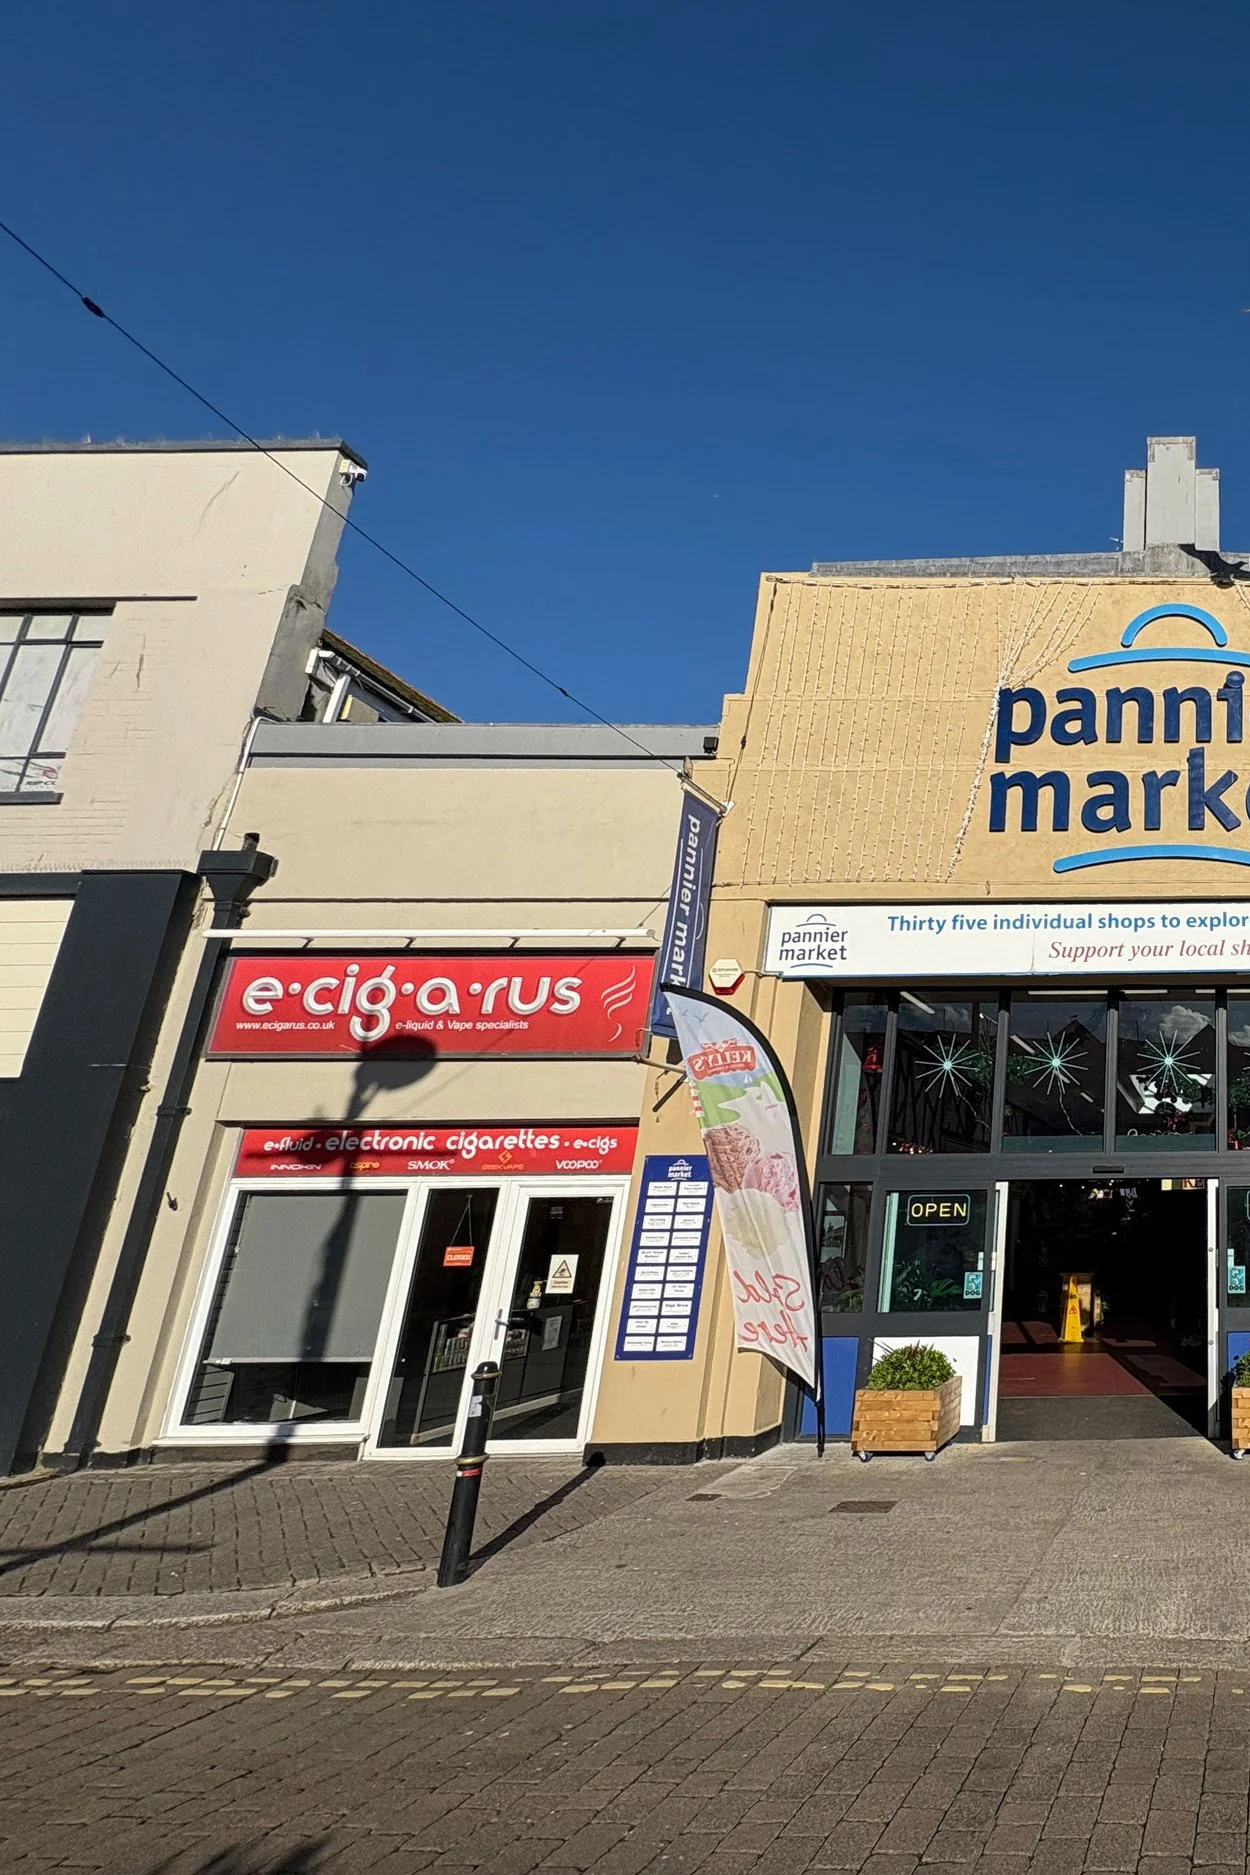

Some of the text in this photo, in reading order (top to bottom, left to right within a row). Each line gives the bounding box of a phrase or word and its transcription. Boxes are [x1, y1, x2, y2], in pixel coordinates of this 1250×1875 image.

[666, 814, 701, 1014] pannier mark
[887, 915, 946, 934] Thirty
[952, 914, 988, 931] five
[993, 913, 1092, 930] individual
[1098, 913, 1156, 932] shops
[1160, 915, 1181, 929] to
[781, 927, 849, 947] pannier
[779, 944, 848, 961] market
[1049, 941, 1125, 963] Support
[1128, 944, 1174, 962] your
[1179, 940, 1226, 957] local
[235, 1021, 335, 1031] www.ecigarus.co.uk
[395, 1020, 529, 1031] e-liquid & Vape specialists
[325, 1130, 436, 1150] electronic
[446, 1128, 560, 1159] cigarettes
[556, 1160, 600, 1169] VOOPOO
[668, 1165, 693, 1173] pannier
[911, 1203, 967, 1218] OPEN
